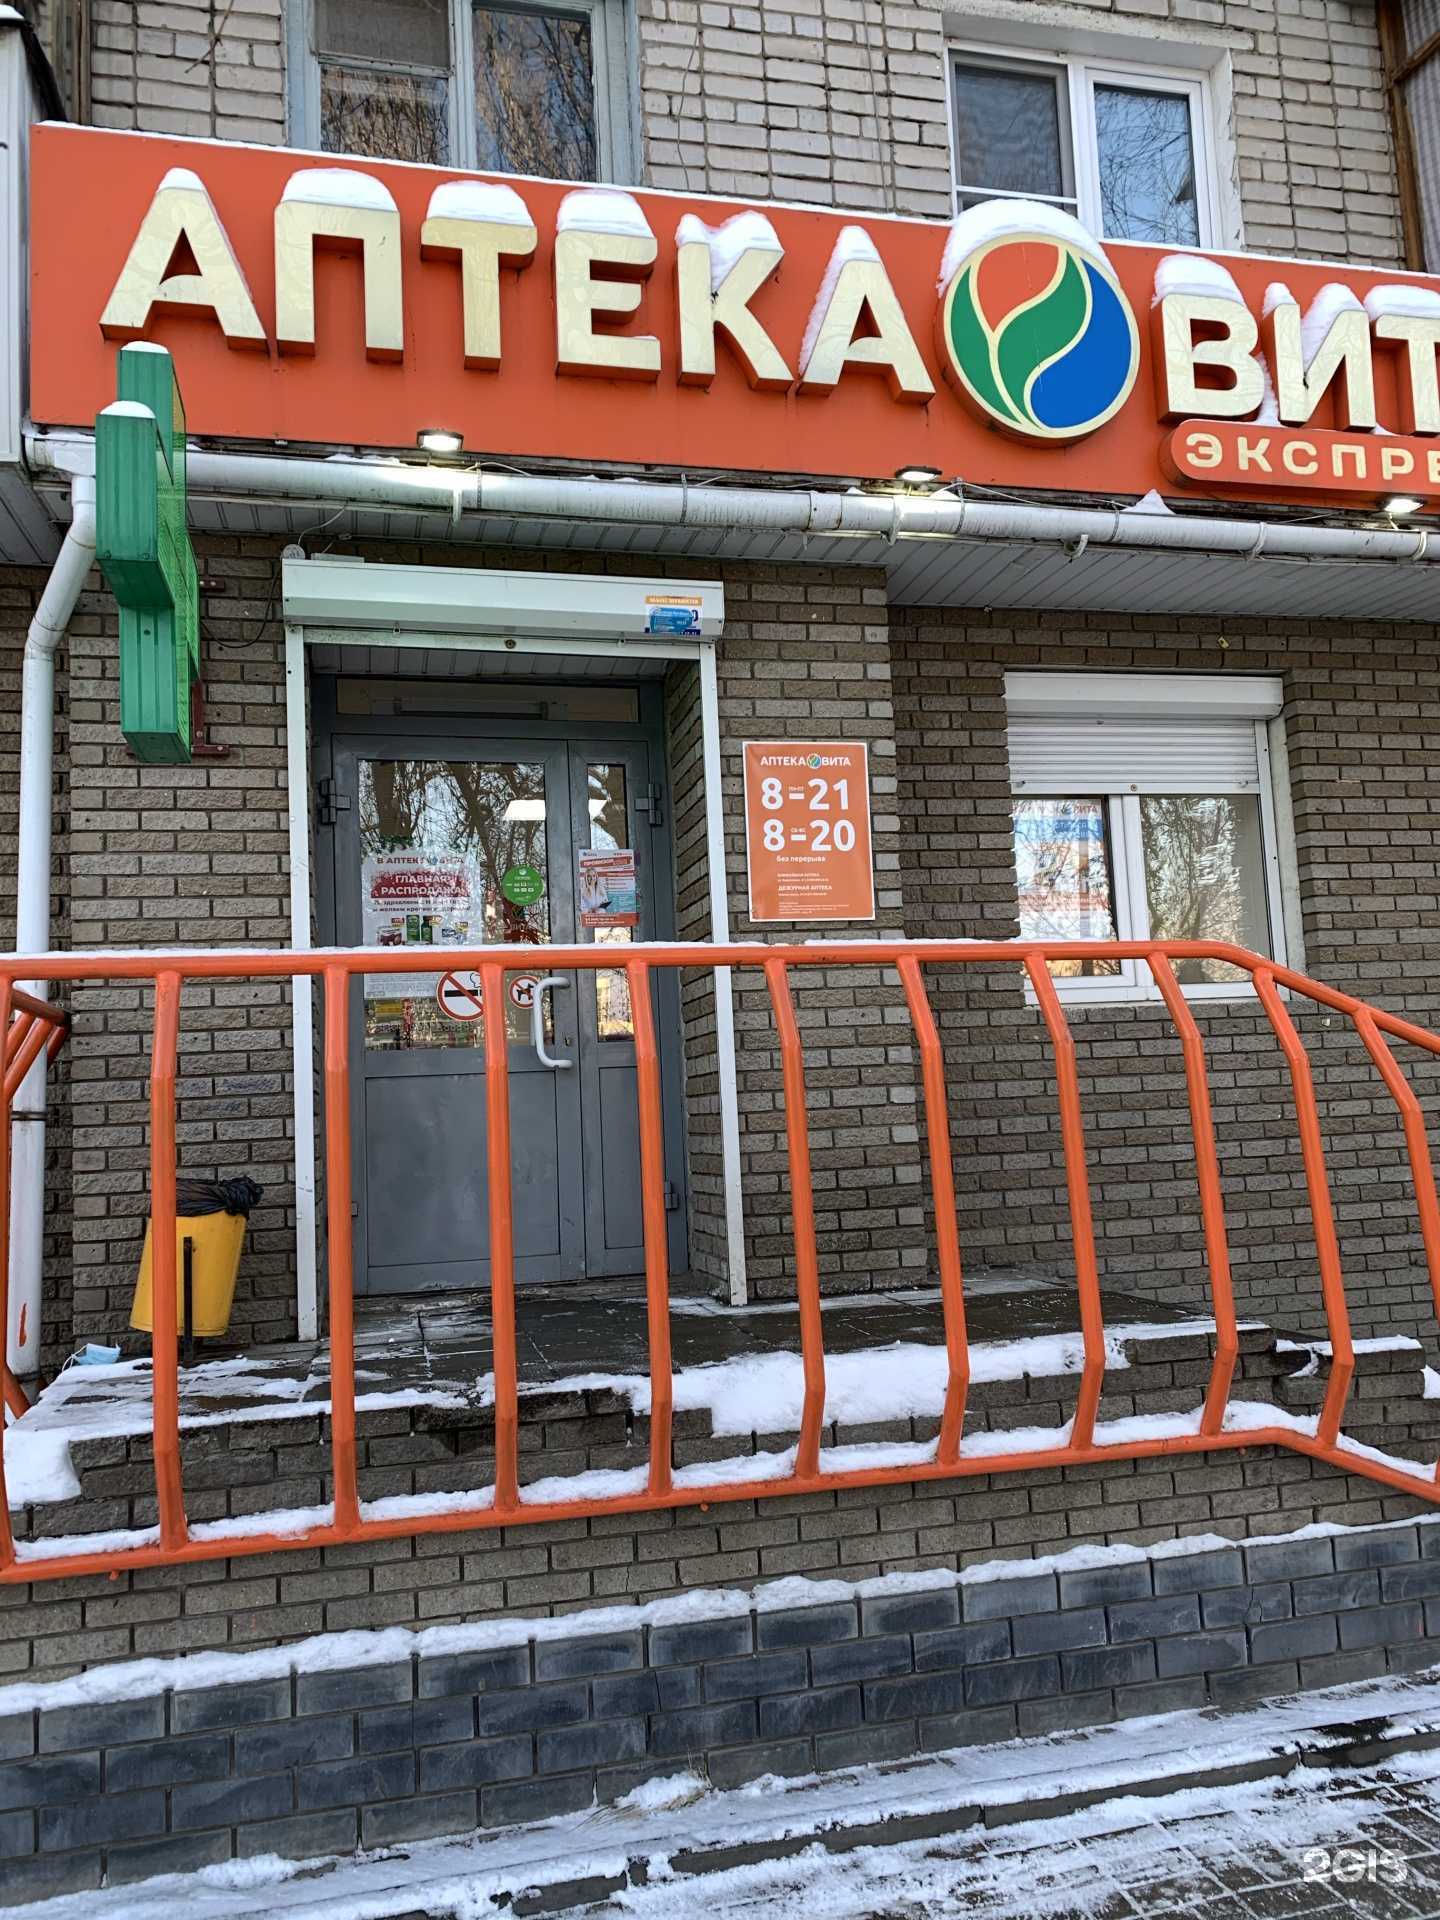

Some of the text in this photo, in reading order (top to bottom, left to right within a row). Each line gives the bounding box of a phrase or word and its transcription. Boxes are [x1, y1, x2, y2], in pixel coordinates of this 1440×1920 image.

[99, 185, 937, 404] АПТЕКА
[760, 756, 851, 767] АПТЕКА ВИТА
[395, 875, 448, 883] ГЛАВНАЯ
[381, 886, 461, 896] РАСПРОДАЖА
